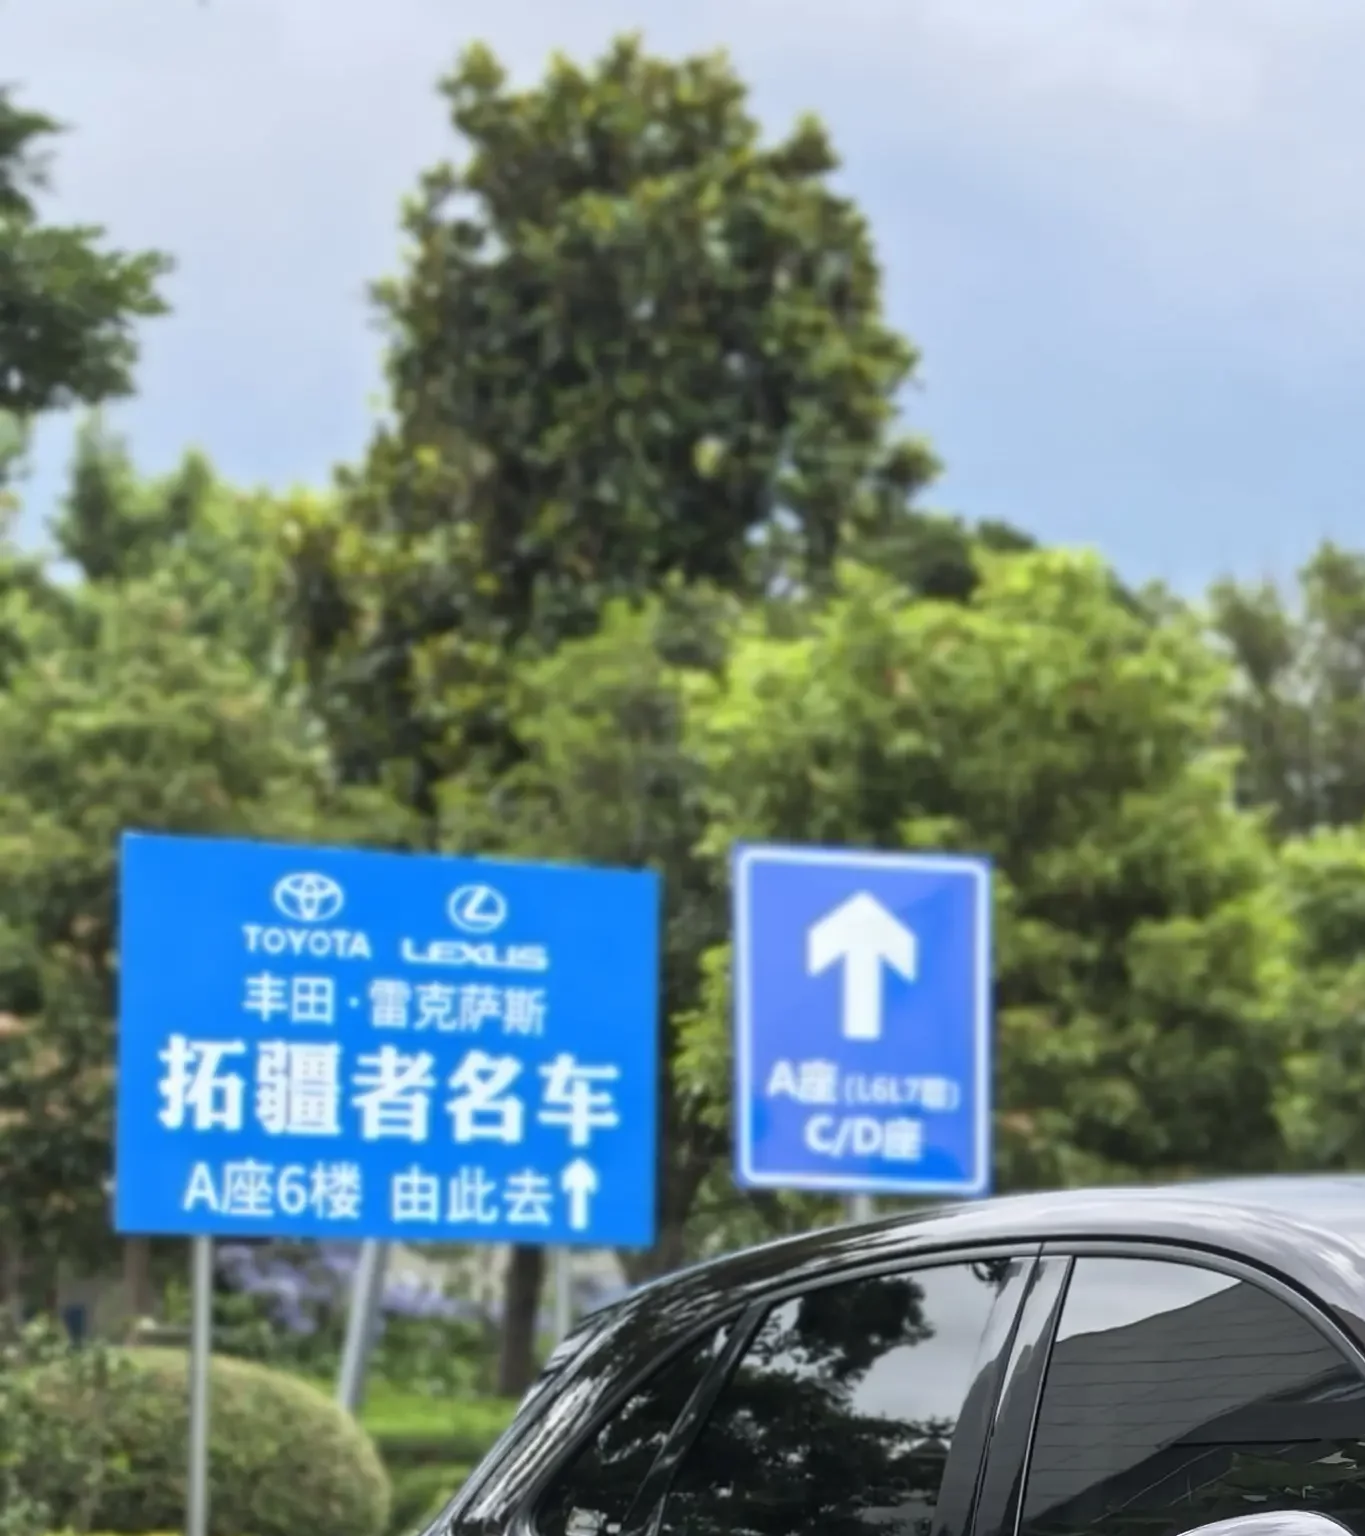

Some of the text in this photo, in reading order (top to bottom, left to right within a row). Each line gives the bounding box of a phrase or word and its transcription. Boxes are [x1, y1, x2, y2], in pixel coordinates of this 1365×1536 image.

[242, 924, 371, 959] TOYOTA
[402, 937, 549, 971] LEXUS
[157, 1033, 621, 1148] 拓疆者名车
[183, 1159, 554, 1227] A座6楼 由此去
